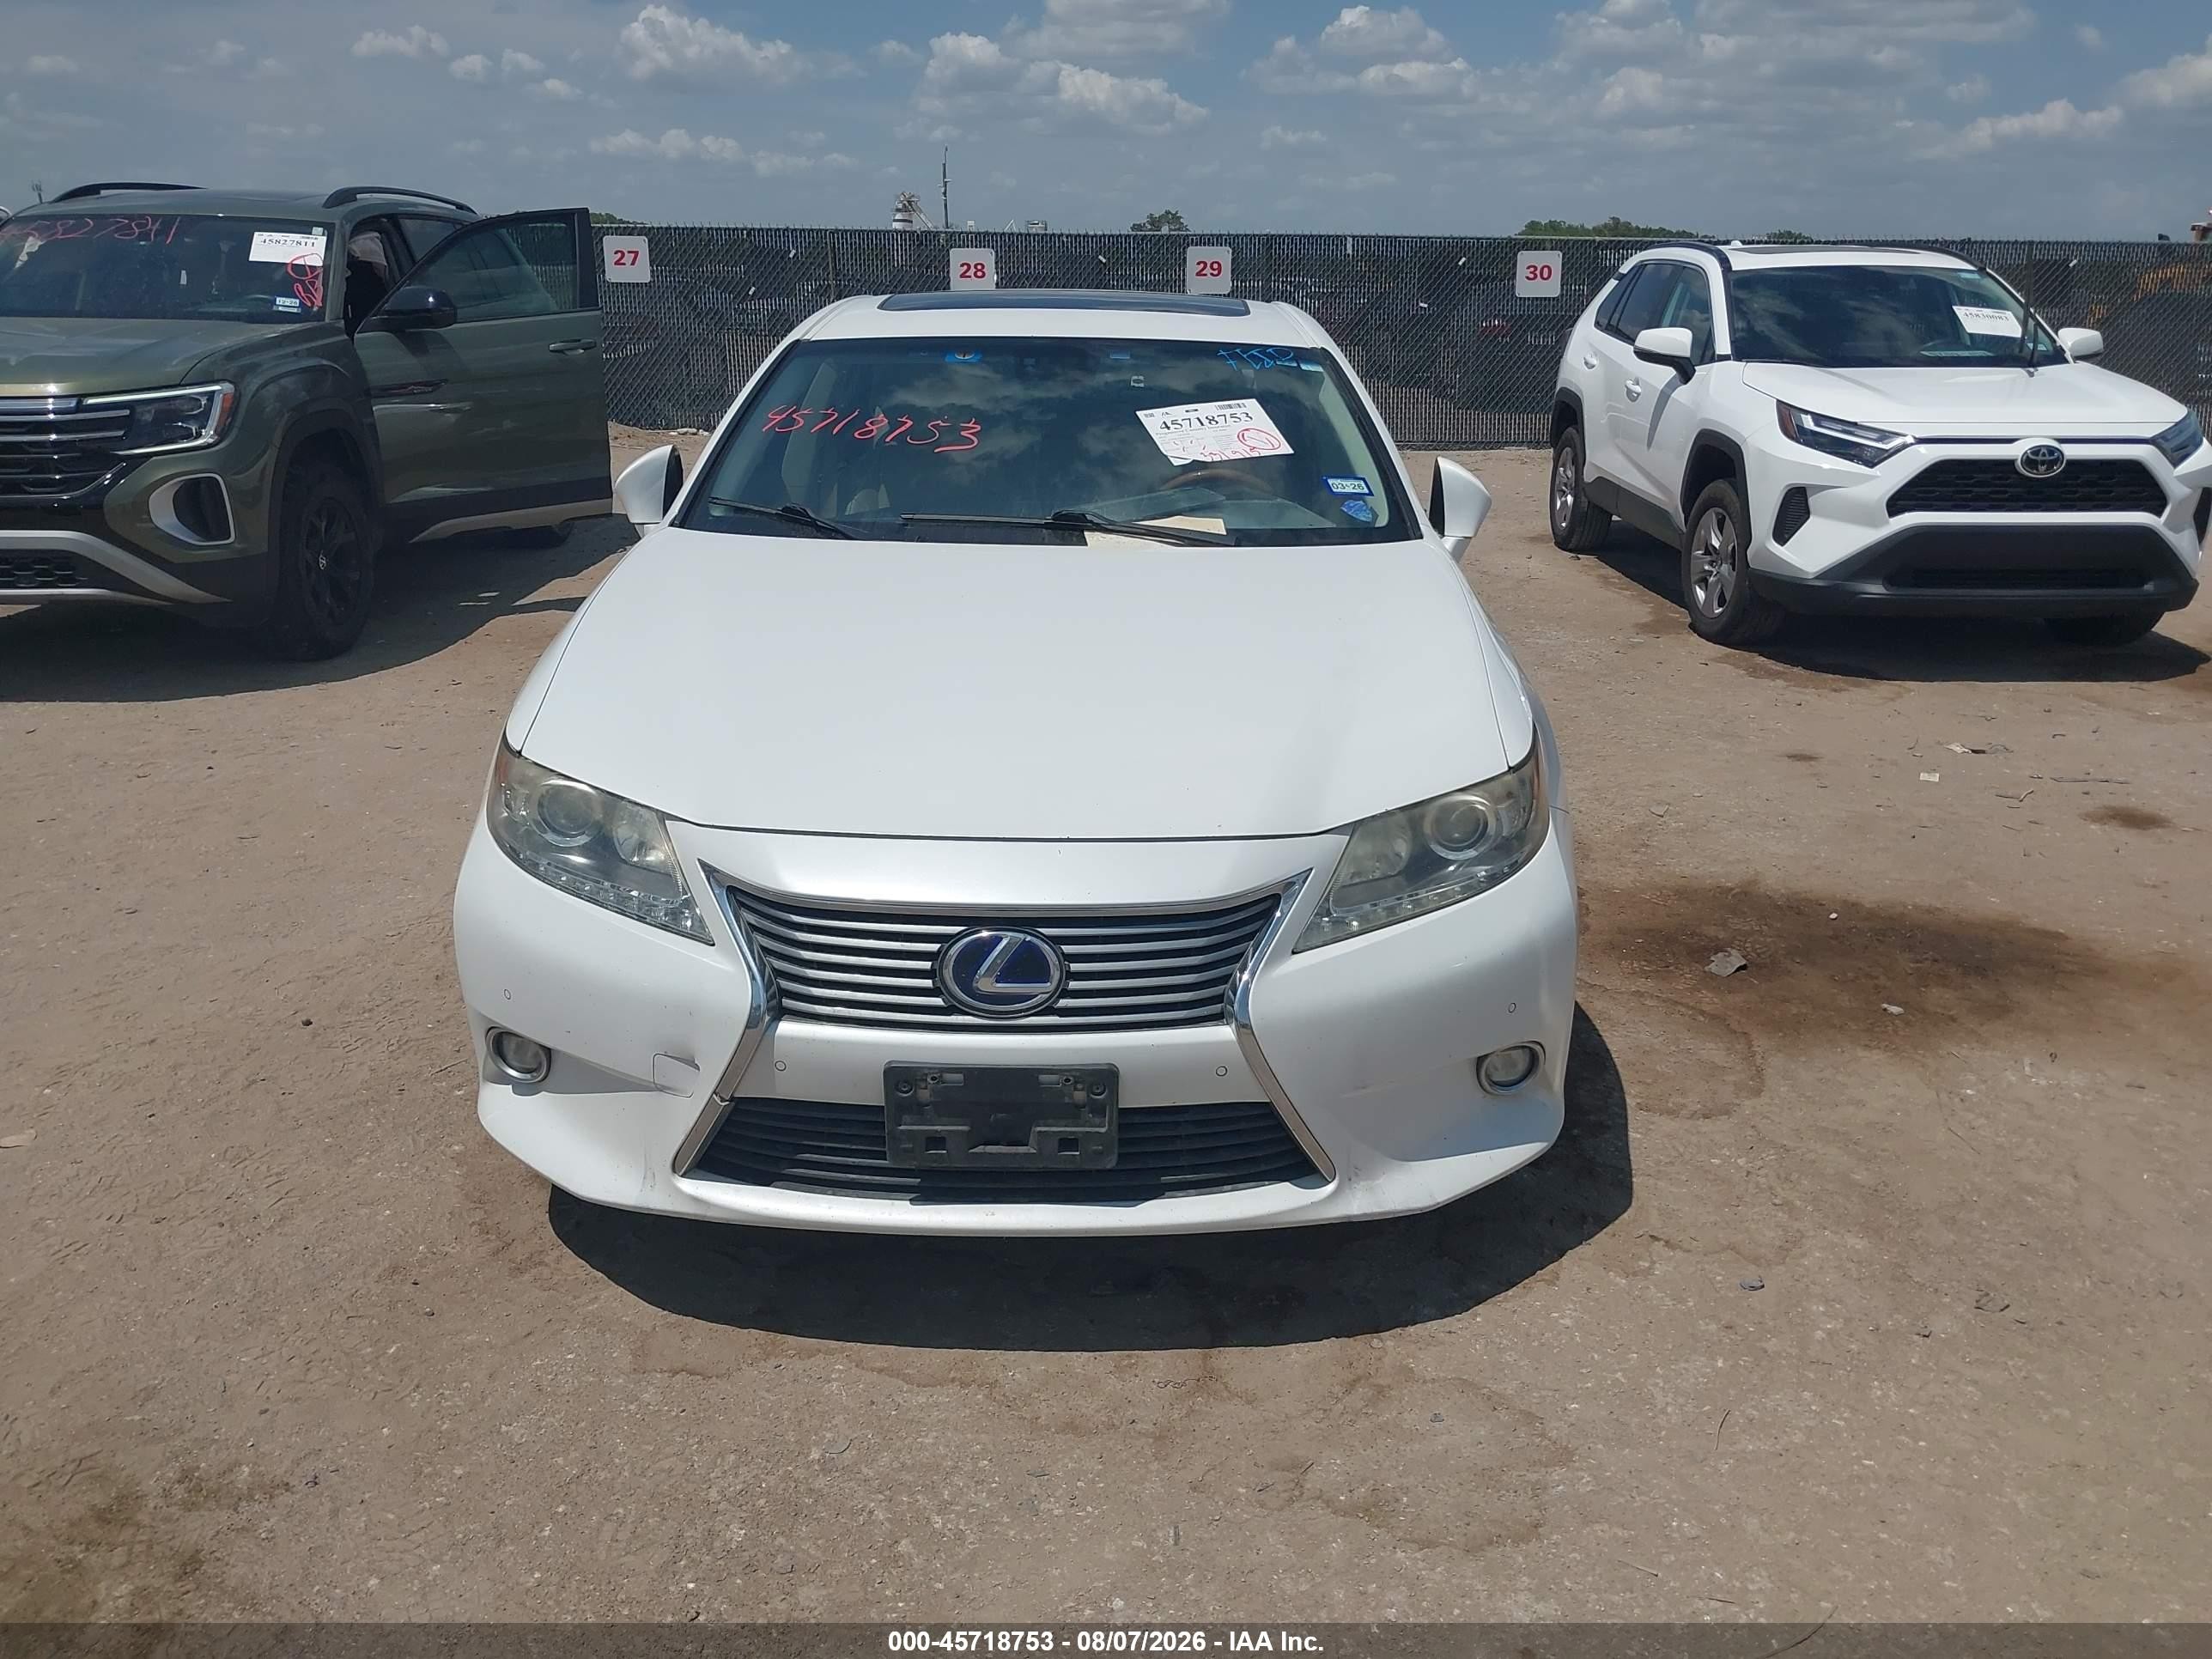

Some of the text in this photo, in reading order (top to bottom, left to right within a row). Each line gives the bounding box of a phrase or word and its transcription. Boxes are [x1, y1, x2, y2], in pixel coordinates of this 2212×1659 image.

[613, 250, 640, 266] 27
[959, 262, 987, 279] 28
[1195, 260, 1223, 277] 29
[1525, 264, 1553, 281] 30
[763, 405, 981, 453] 45718753
[1159, 411, 1254, 431] 45718753
